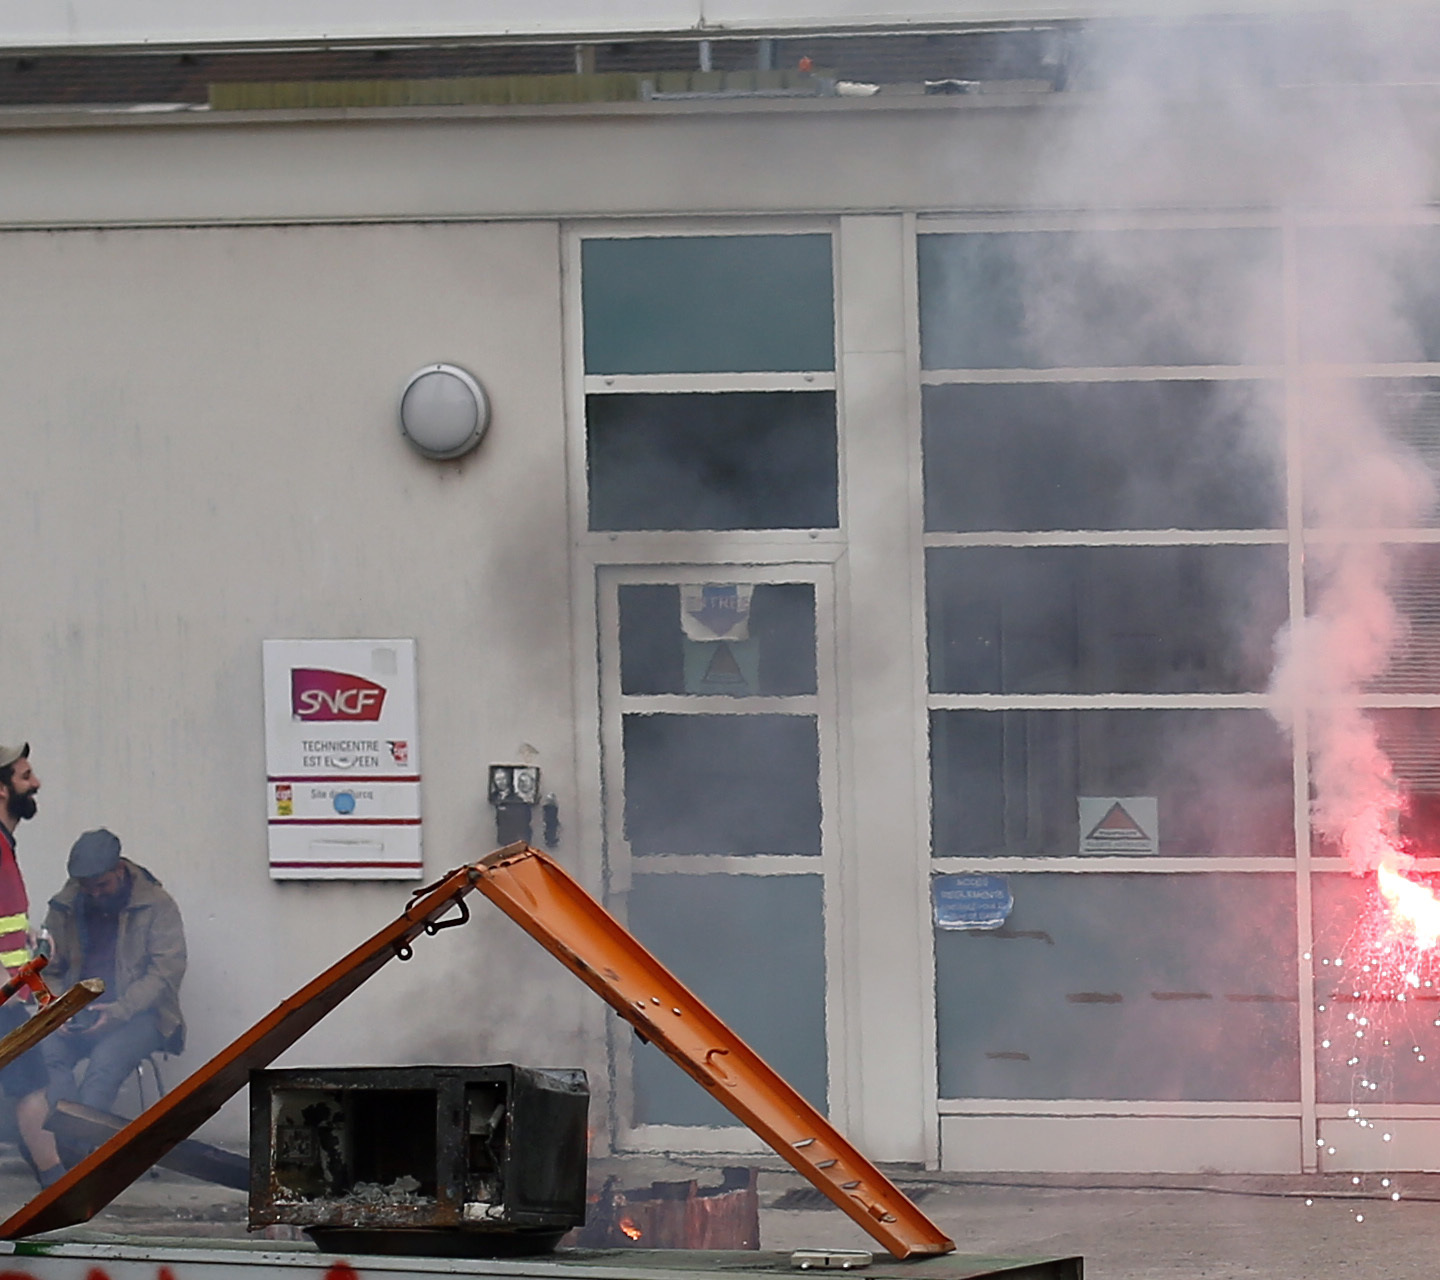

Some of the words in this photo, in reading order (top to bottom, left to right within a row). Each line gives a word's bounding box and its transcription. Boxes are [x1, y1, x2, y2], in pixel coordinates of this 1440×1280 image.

[297, 688, 380, 715] SNCF
[302, 740, 379, 751] TECHNICENTRE
[303, 756, 321, 767] EST
[311, 789, 327, 799] Site
